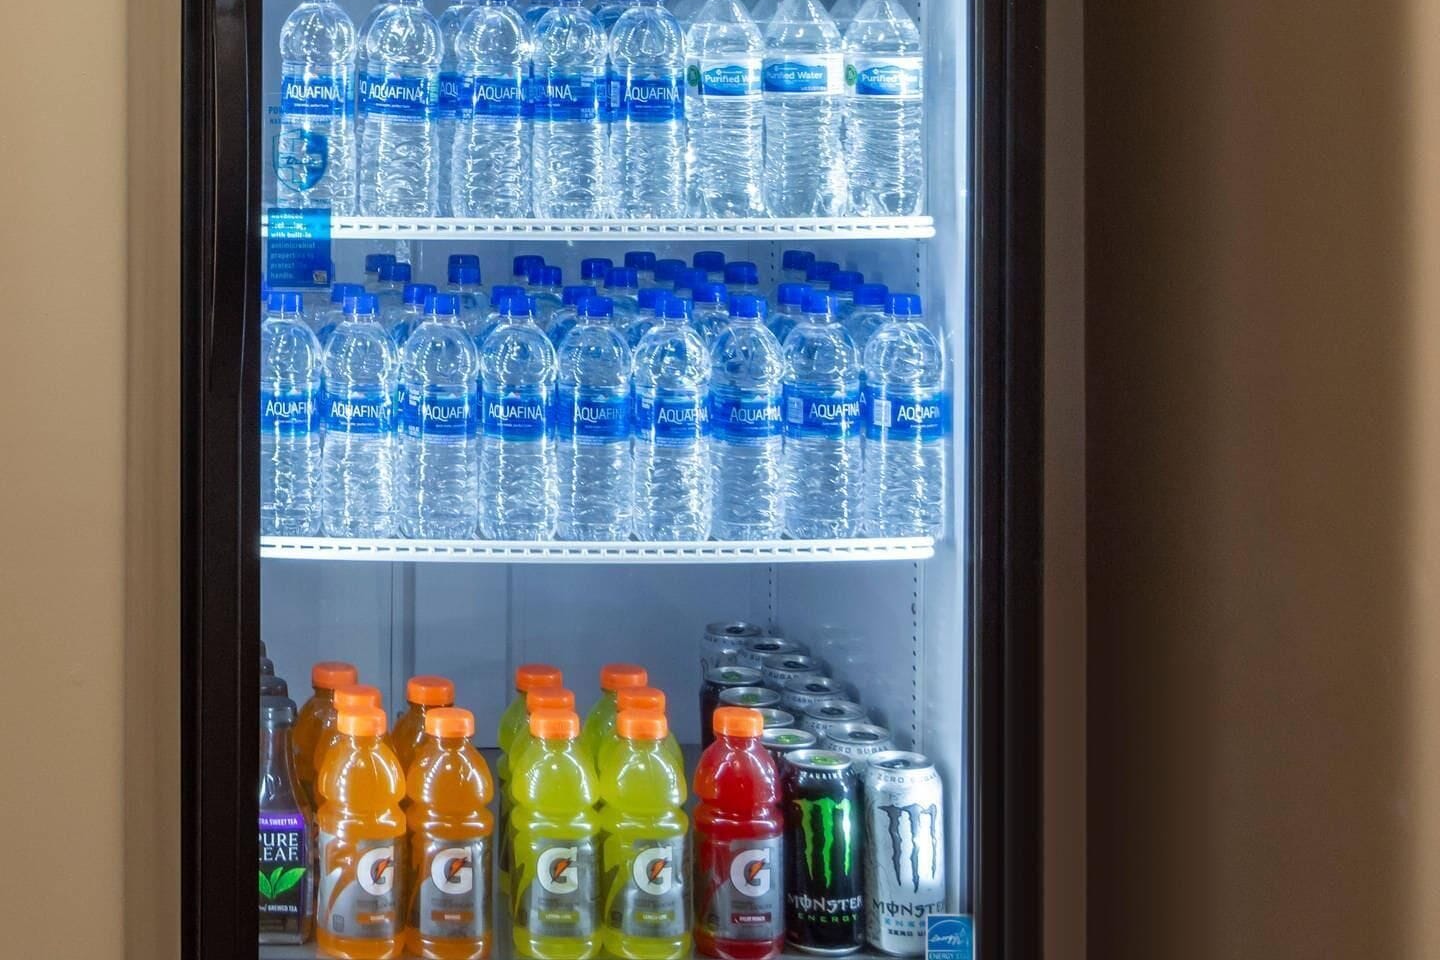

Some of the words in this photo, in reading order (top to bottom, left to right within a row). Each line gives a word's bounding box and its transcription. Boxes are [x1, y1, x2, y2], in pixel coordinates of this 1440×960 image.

[705, 74, 740, 84] Purified
[797, 71, 823, 80] Water
[862, 74, 897, 83] Purified
[285, 82, 341, 101] AQUAFINA
[368, 83, 424, 102] AQUAFINA
[624, 86, 680, 103] AQUAFINA
[331, 401, 386, 418] AQUAFINA
[488, 403, 543, 421] AQUAFINA
[657, 407, 709, 424] AQUAFINA
[729, 406, 782, 424] AQUAFINA
[809, 401, 860, 419] AQUAFINA
[828, 743, 852, 754] ZERO
[877, 774, 905, 784] ZERO
[431, 847, 473, 895] G
[537, 846, 578, 894] G
[633, 846, 672, 895] G
[730, 847, 771, 897] G
[787, 894, 864, 912] MONSTER
[797, 913, 858, 923] ENERGY
